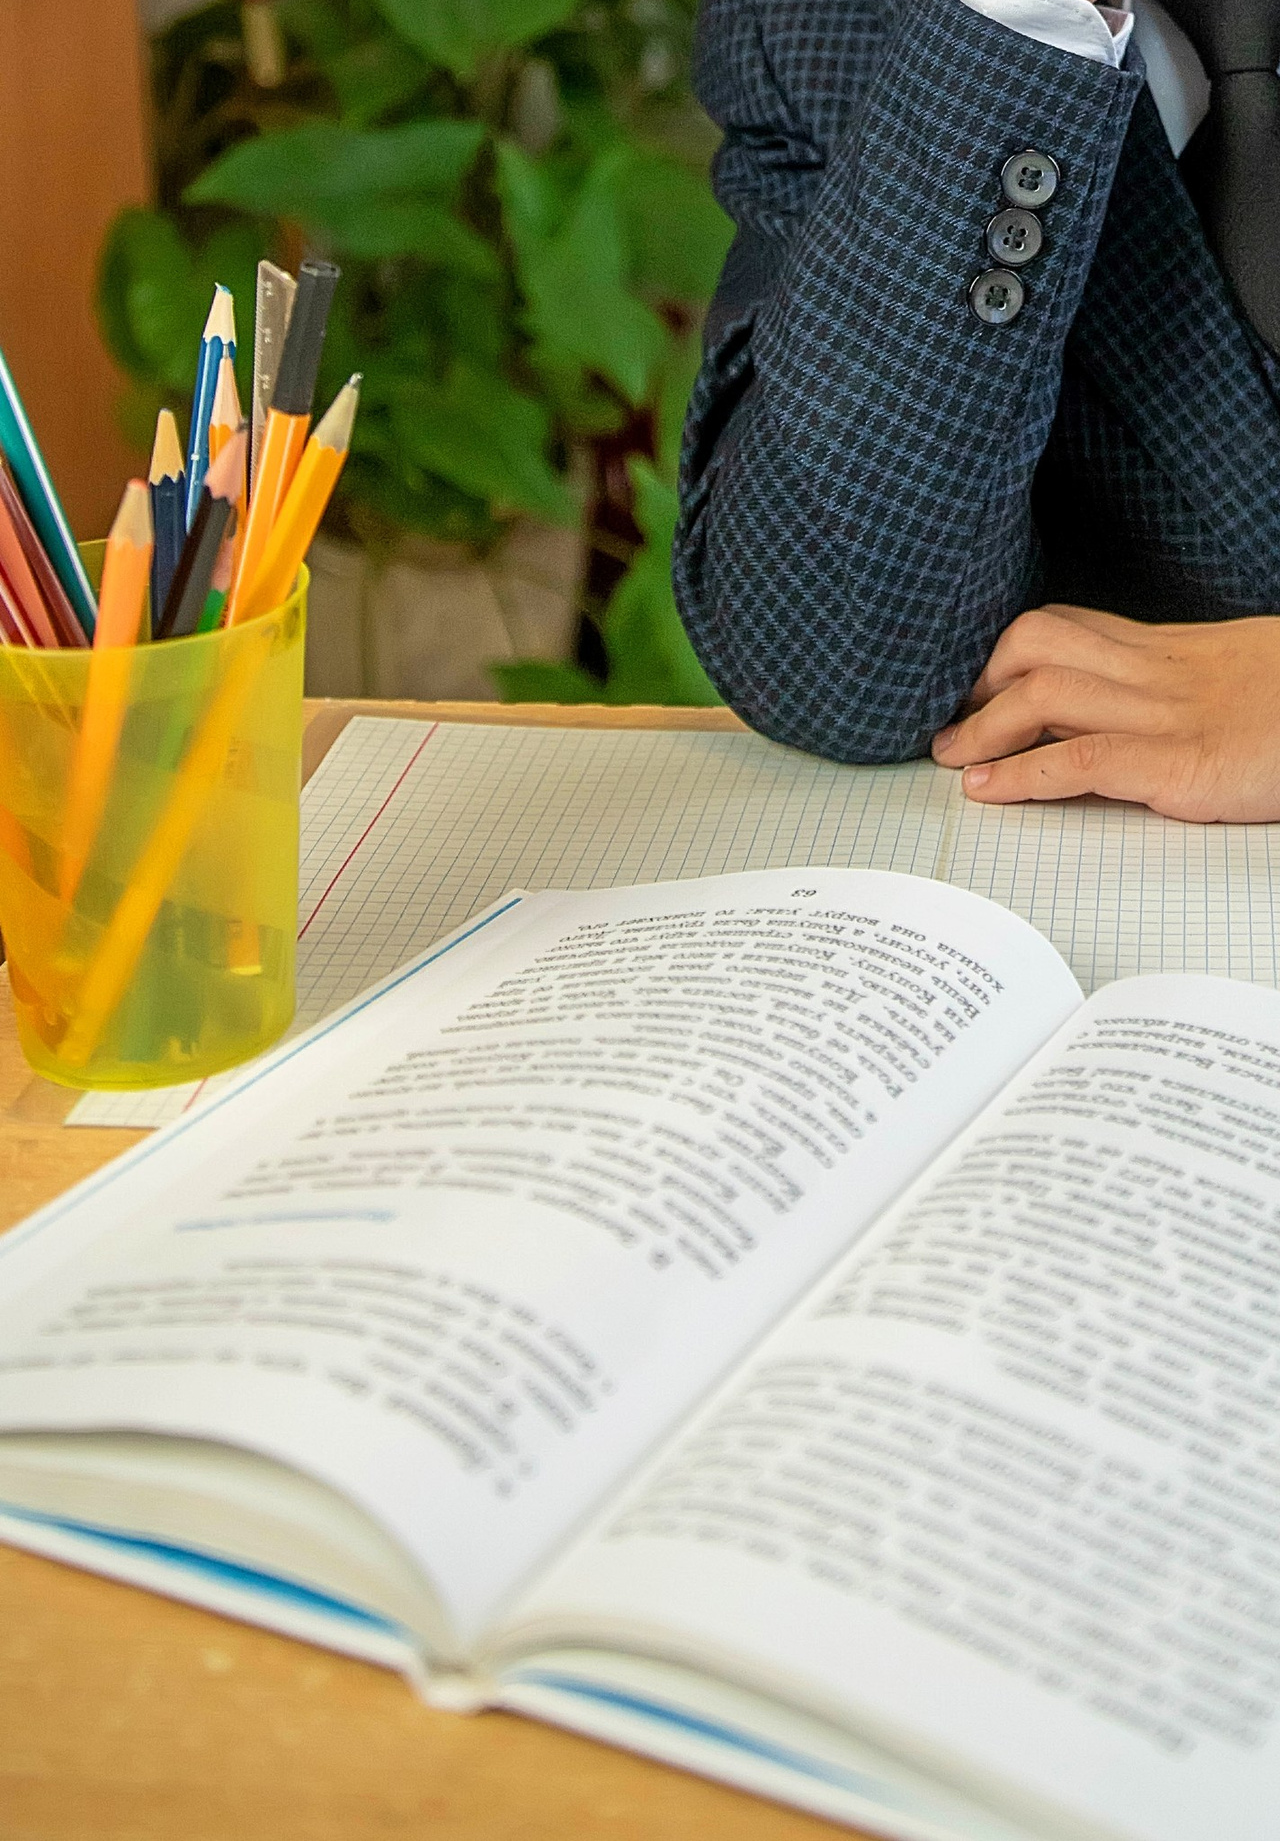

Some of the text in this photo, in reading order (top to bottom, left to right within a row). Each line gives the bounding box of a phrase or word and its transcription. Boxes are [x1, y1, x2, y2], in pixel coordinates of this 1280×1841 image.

[790, 889, 817, 899] 63
[763, 918, 849, 933] Копуша
[806, 909, 882, 925] вокруг
[848, 928, 867, 936] а
[887, 924, 928, 942] она
[749, 941, 838, 959] Копуша
[934, 941, 1006, 994] ходила
[818, 981, 868, 1001] Для
[853, 976, 930, 1019] землю,
[927, 974, 982, 1019] Вещь
[951, 970, 995, 1007] чит,
[931, 1019, 958, 1043] на
[942, 1006, 971, 1032] ли
[829, 1020, 920, 1084] открыть
[854, 1053, 905, 1099] Роль
